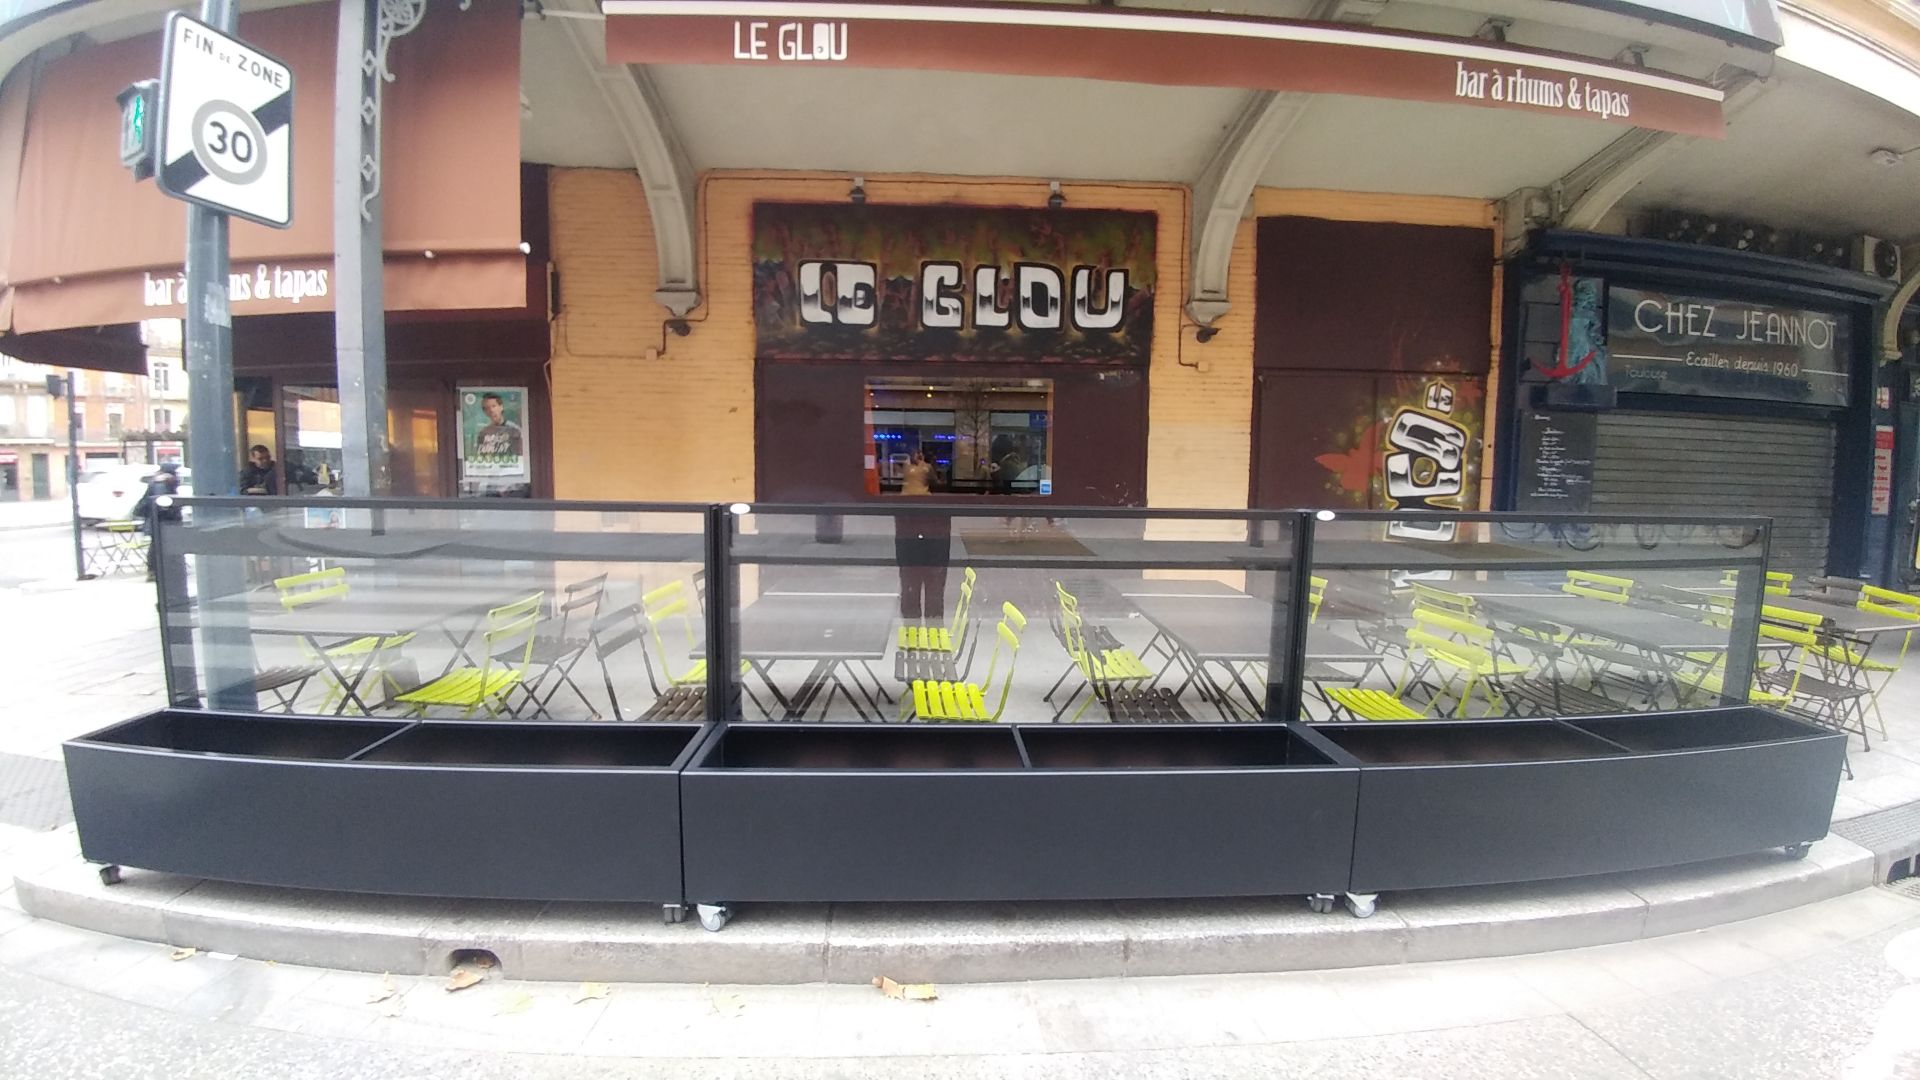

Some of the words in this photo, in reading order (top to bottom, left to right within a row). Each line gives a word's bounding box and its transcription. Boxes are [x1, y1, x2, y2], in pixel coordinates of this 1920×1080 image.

[183, 28, 214, 55] FIN
[237, 54, 283, 89] ZONE
[734, 21, 768, 60] LE
[779, 22, 848, 60] GLOU
[1455, 61, 1488, 99] bar
[1491, 68, 1504, 101] à
[1506, 69, 1564, 108] rhums
[1567, 77, 1583, 110] &
[1585, 82, 1630, 119] tapas
[208, 120, 253, 163] 30
[144, 272, 175, 306] bar
[254, 264, 271, 299] &
[273, 266, 328, 303] tapas
[800, 262, 876, 326] LE
[921, 263, 1126, 330] GLOU
[1634, 300, 1716, 338] CHEZ
[1736, 310, 1837, 350] JEANNOT
[1686, 351, 1730, 370] Ecailler
[1733, 356, 1769, 374] depuis
[1772, 361, 1798, 378] 1960
